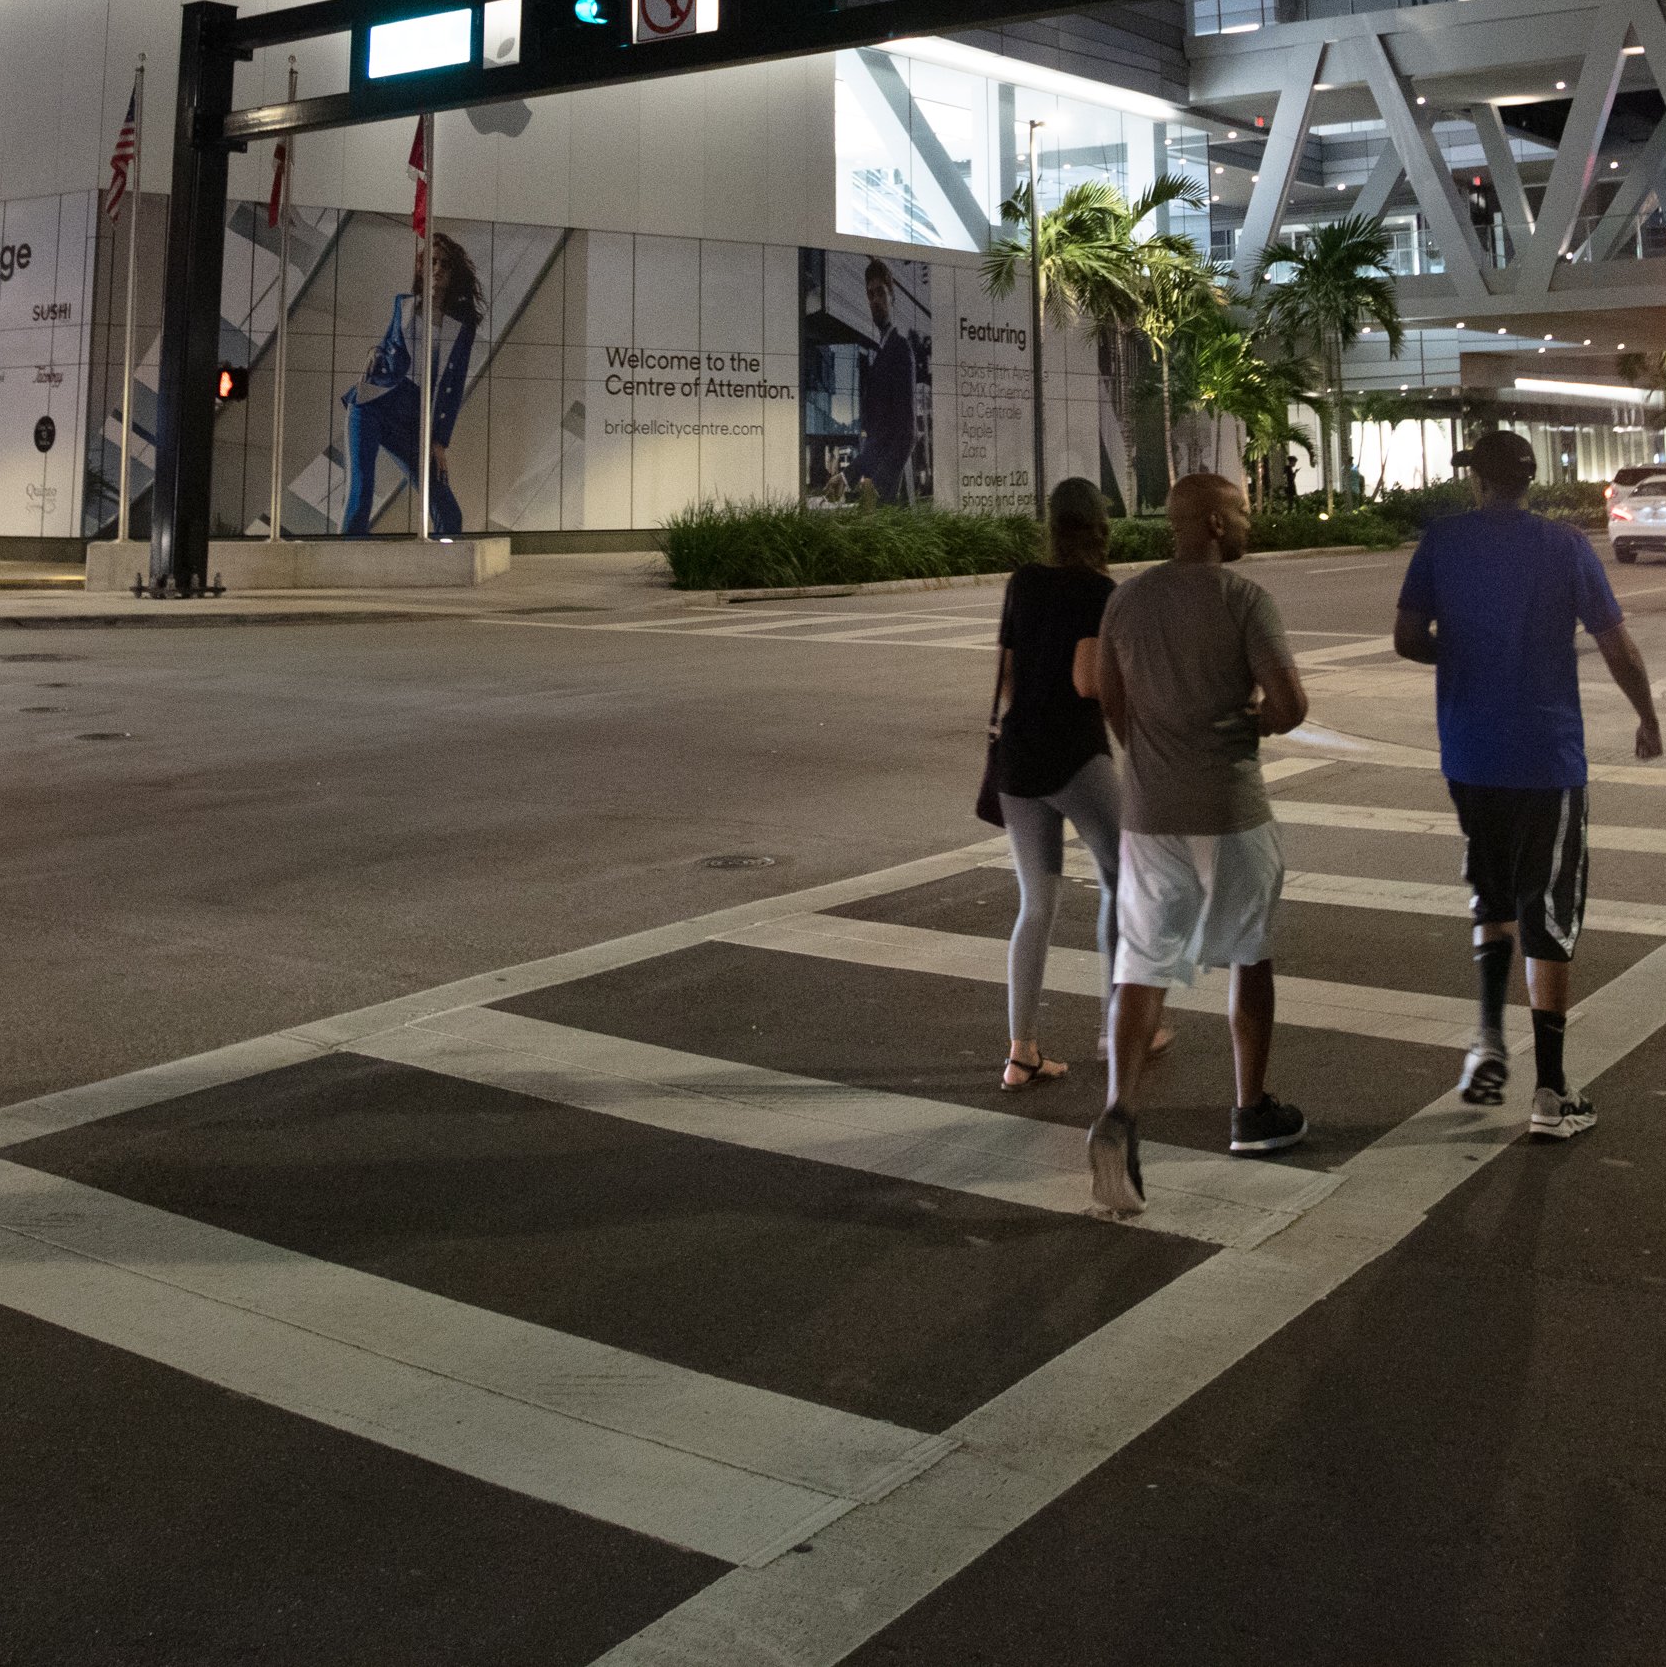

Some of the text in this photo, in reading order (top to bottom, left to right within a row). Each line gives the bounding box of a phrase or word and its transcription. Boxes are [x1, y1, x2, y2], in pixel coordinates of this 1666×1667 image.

[33, 303, 71, 321] SUSHI
[960, 317, 1026, 351] Featuring
[605, 346, 760, 372] Welcome to the
[605, 374, 795, 400] Centre of Attention.
[960, 402, 1022, 420] La Centrale
[604, 419, 764, 438] brickellcitycentre.com
[962, 422, 993, 439] Apple
[962, 442, 987, 458] Zara
[962, 471, 1029, 487] and over 120
[962, 492, 993, 509] shops
[995, 491, 1015, 507] and
